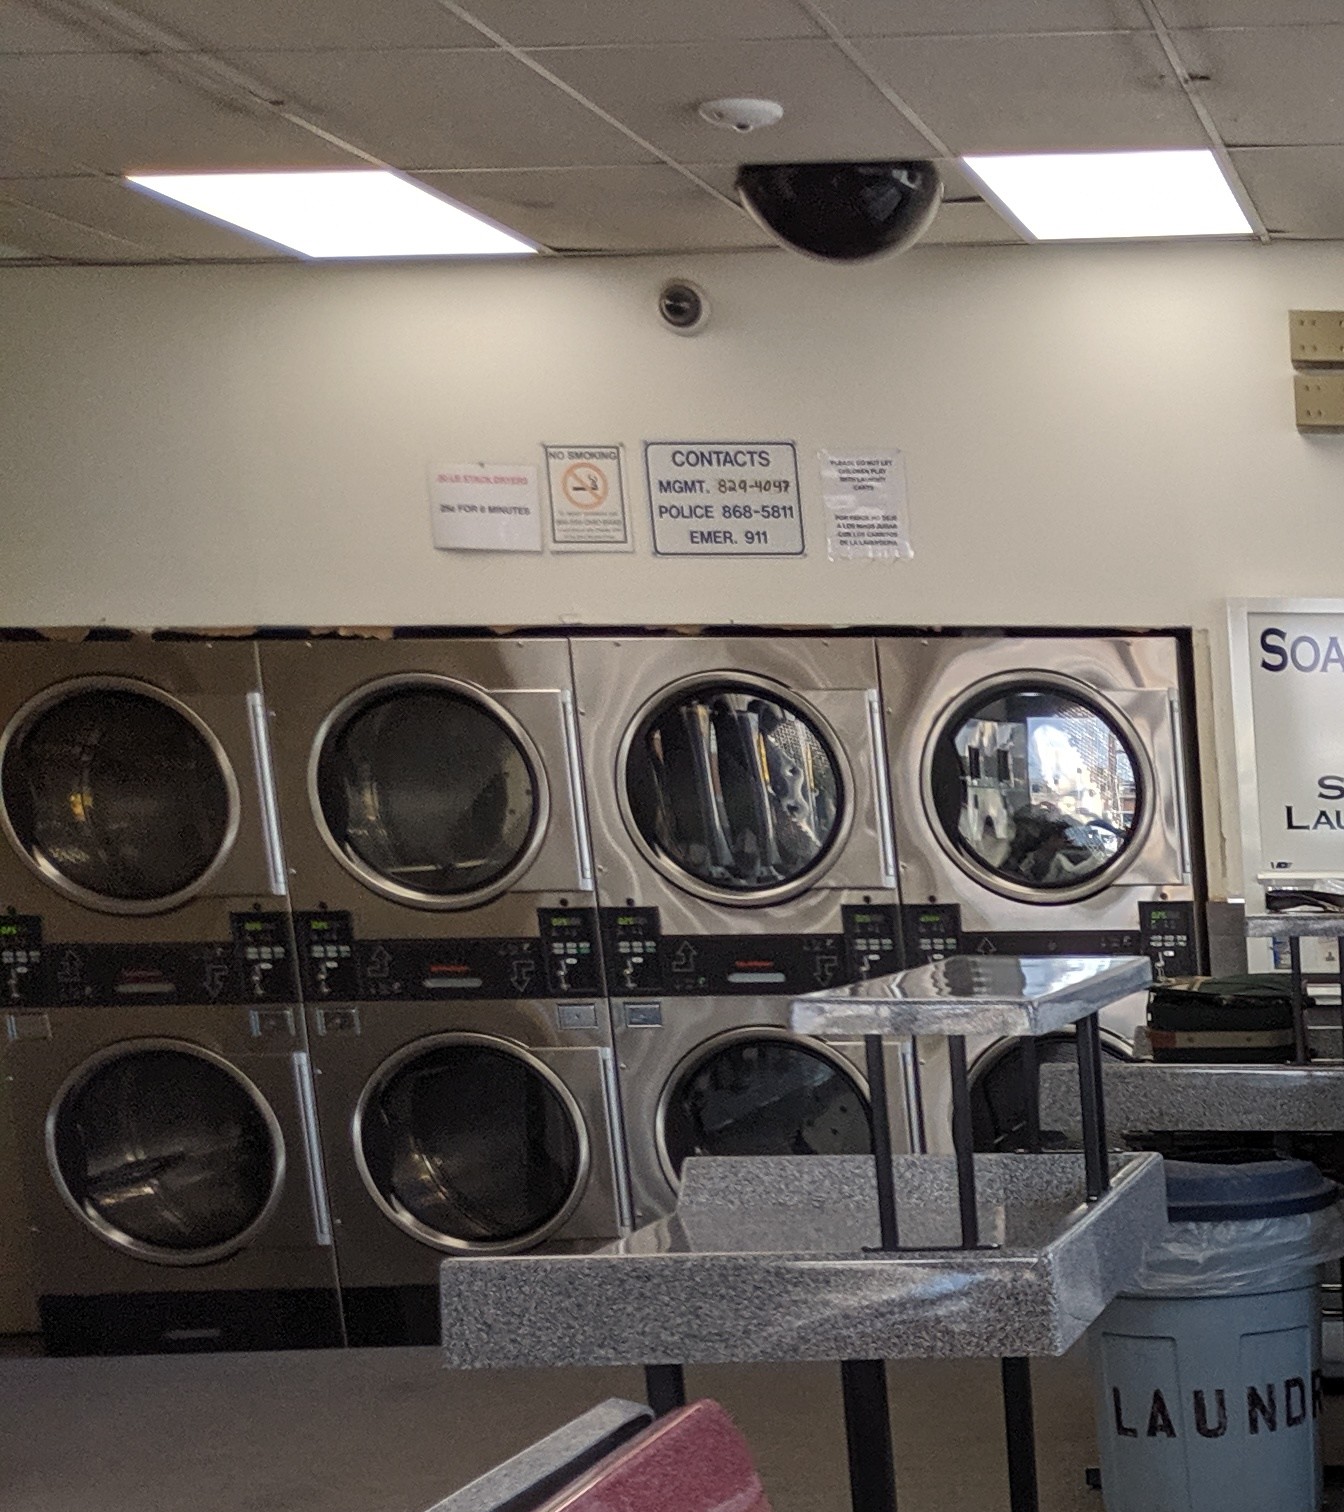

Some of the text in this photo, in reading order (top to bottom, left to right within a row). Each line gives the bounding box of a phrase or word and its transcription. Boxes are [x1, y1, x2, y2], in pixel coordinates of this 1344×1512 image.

[549, 451, 617, 460] NO SMOKING
[672, 450, 770, 468] CONTACTS
[658, 479, 711, 494] MGMT.
[488, 505, 530, 516] MINUTES
[658, 505, 794, 519] POLICE 868-5811
[689, 530, 768, 545] EMER. 911
